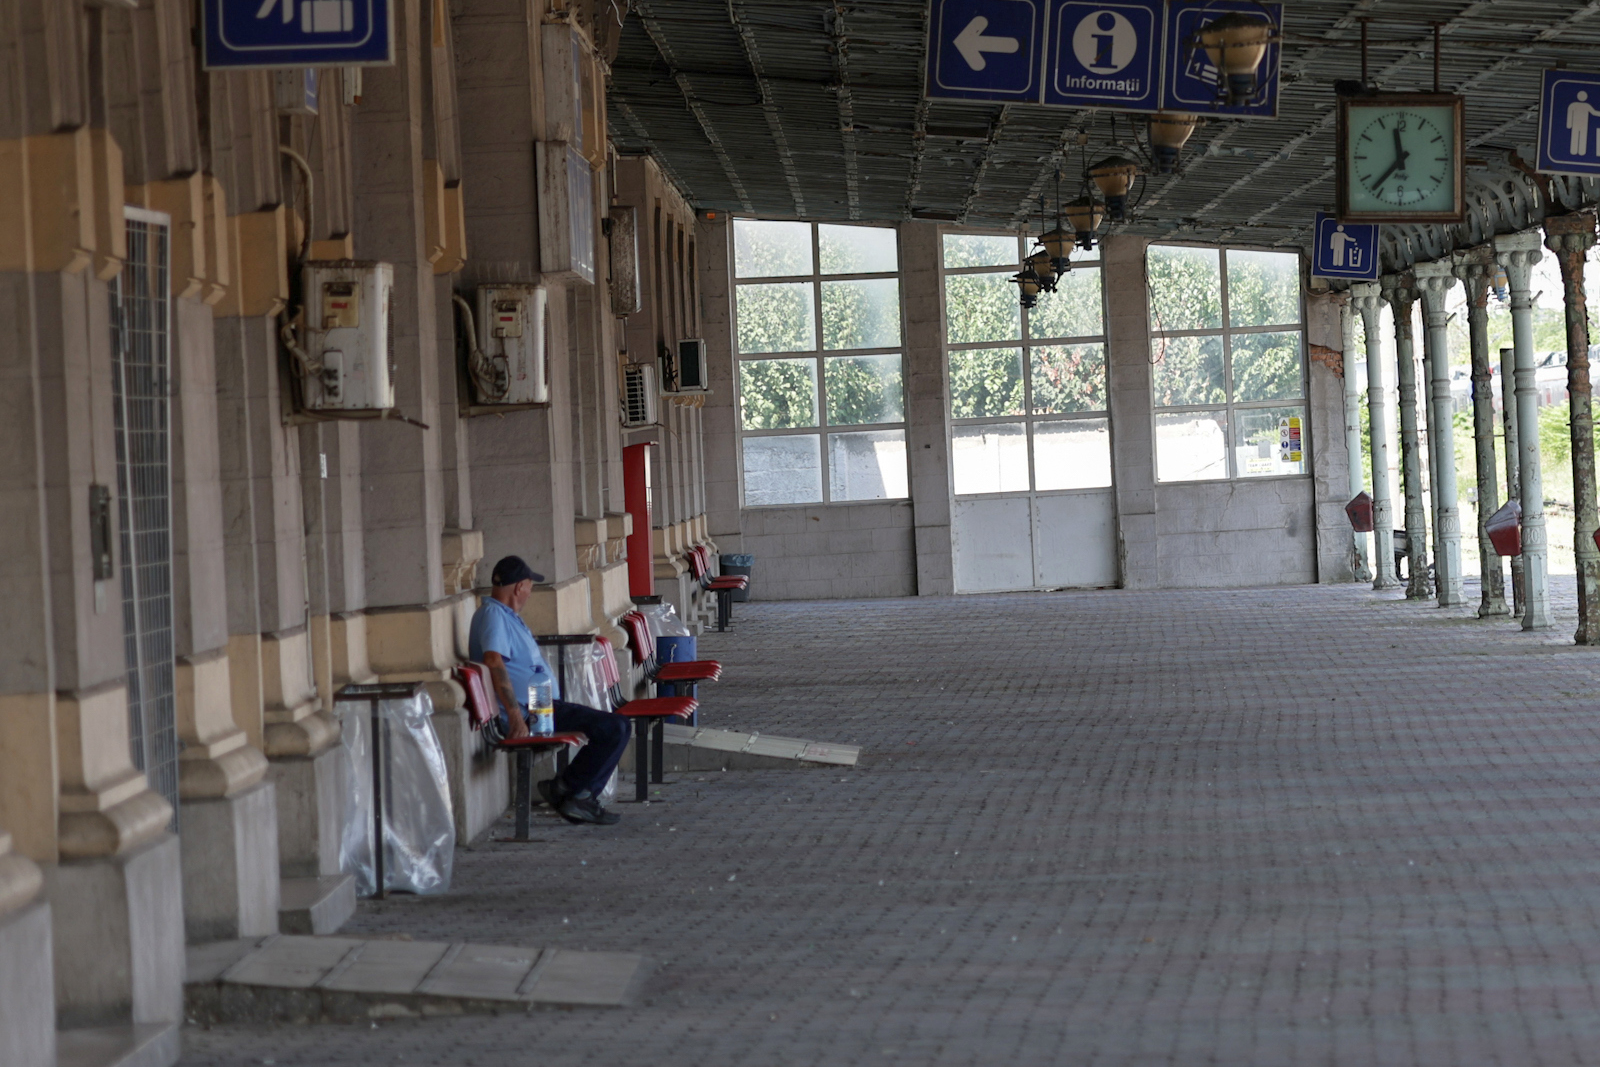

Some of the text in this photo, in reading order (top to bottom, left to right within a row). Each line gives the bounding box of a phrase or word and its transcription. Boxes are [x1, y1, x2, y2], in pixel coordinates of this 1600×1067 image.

[1065, 74, 1140, 96] Informații
[1396, 120, 1407, 133] 12
[1396, 185, 1404, 198] 6
